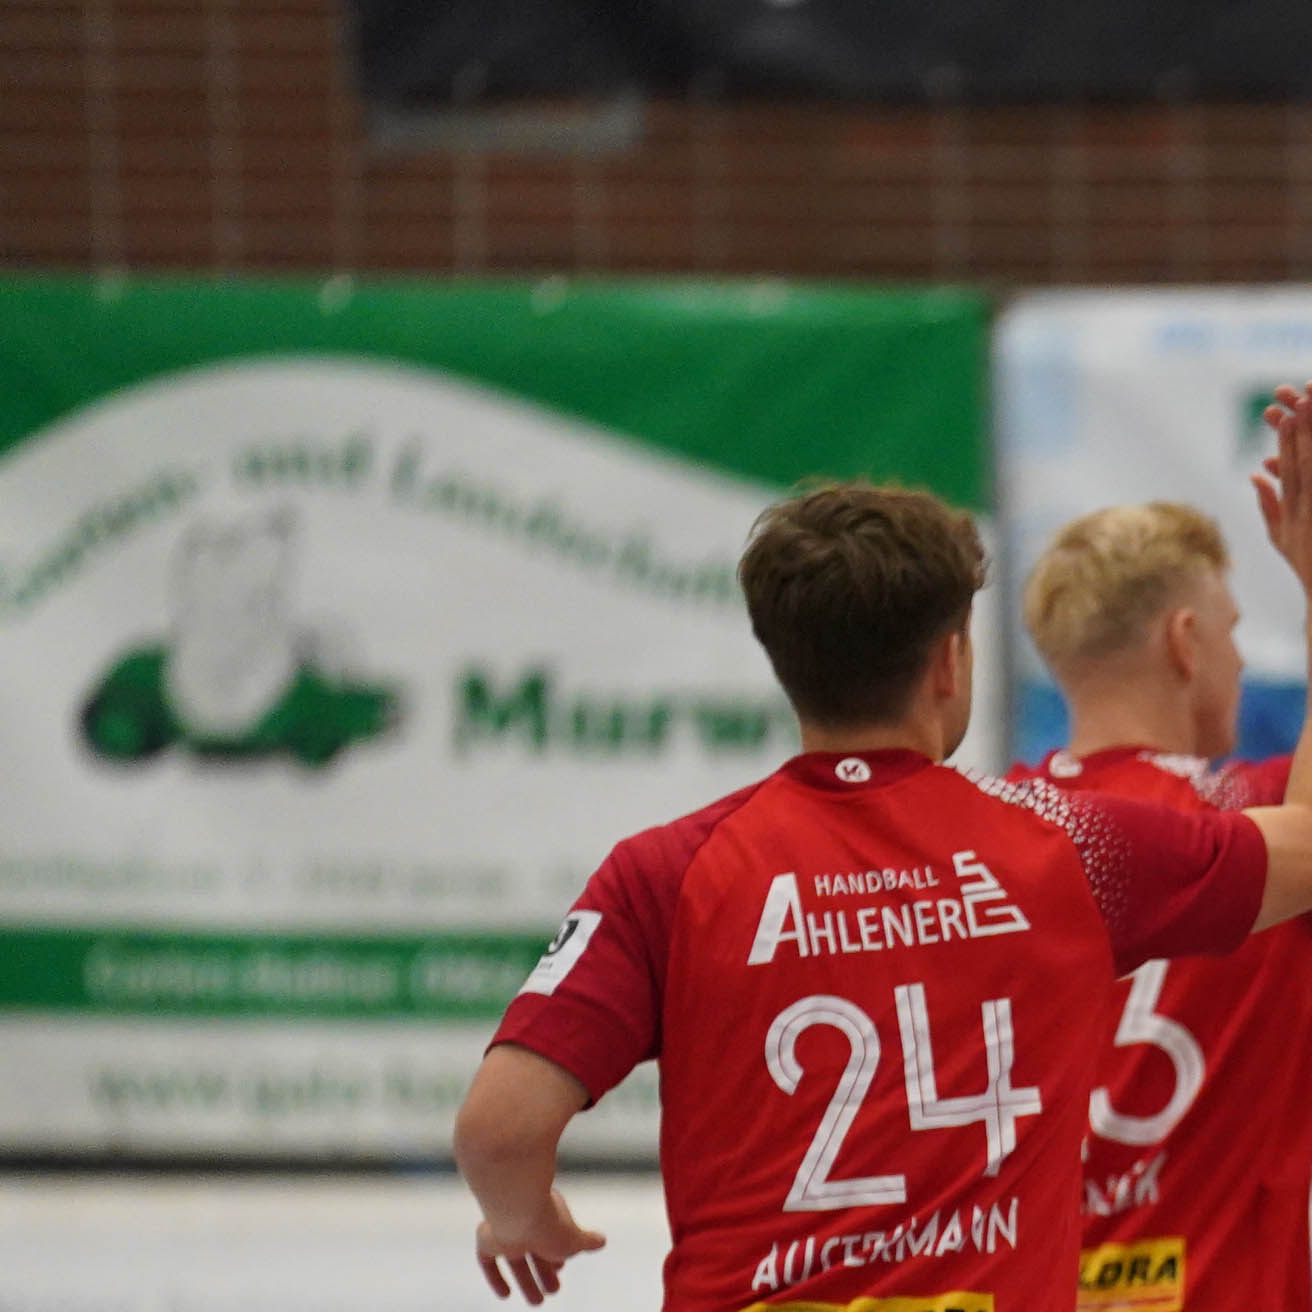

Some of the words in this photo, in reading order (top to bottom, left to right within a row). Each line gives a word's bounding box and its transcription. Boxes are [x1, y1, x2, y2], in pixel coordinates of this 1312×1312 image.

[747, 872, 968, 965] AHLENER
[814, 865, 940, 897] HANDBALL
[764, 982, 1042, 1211] 24
